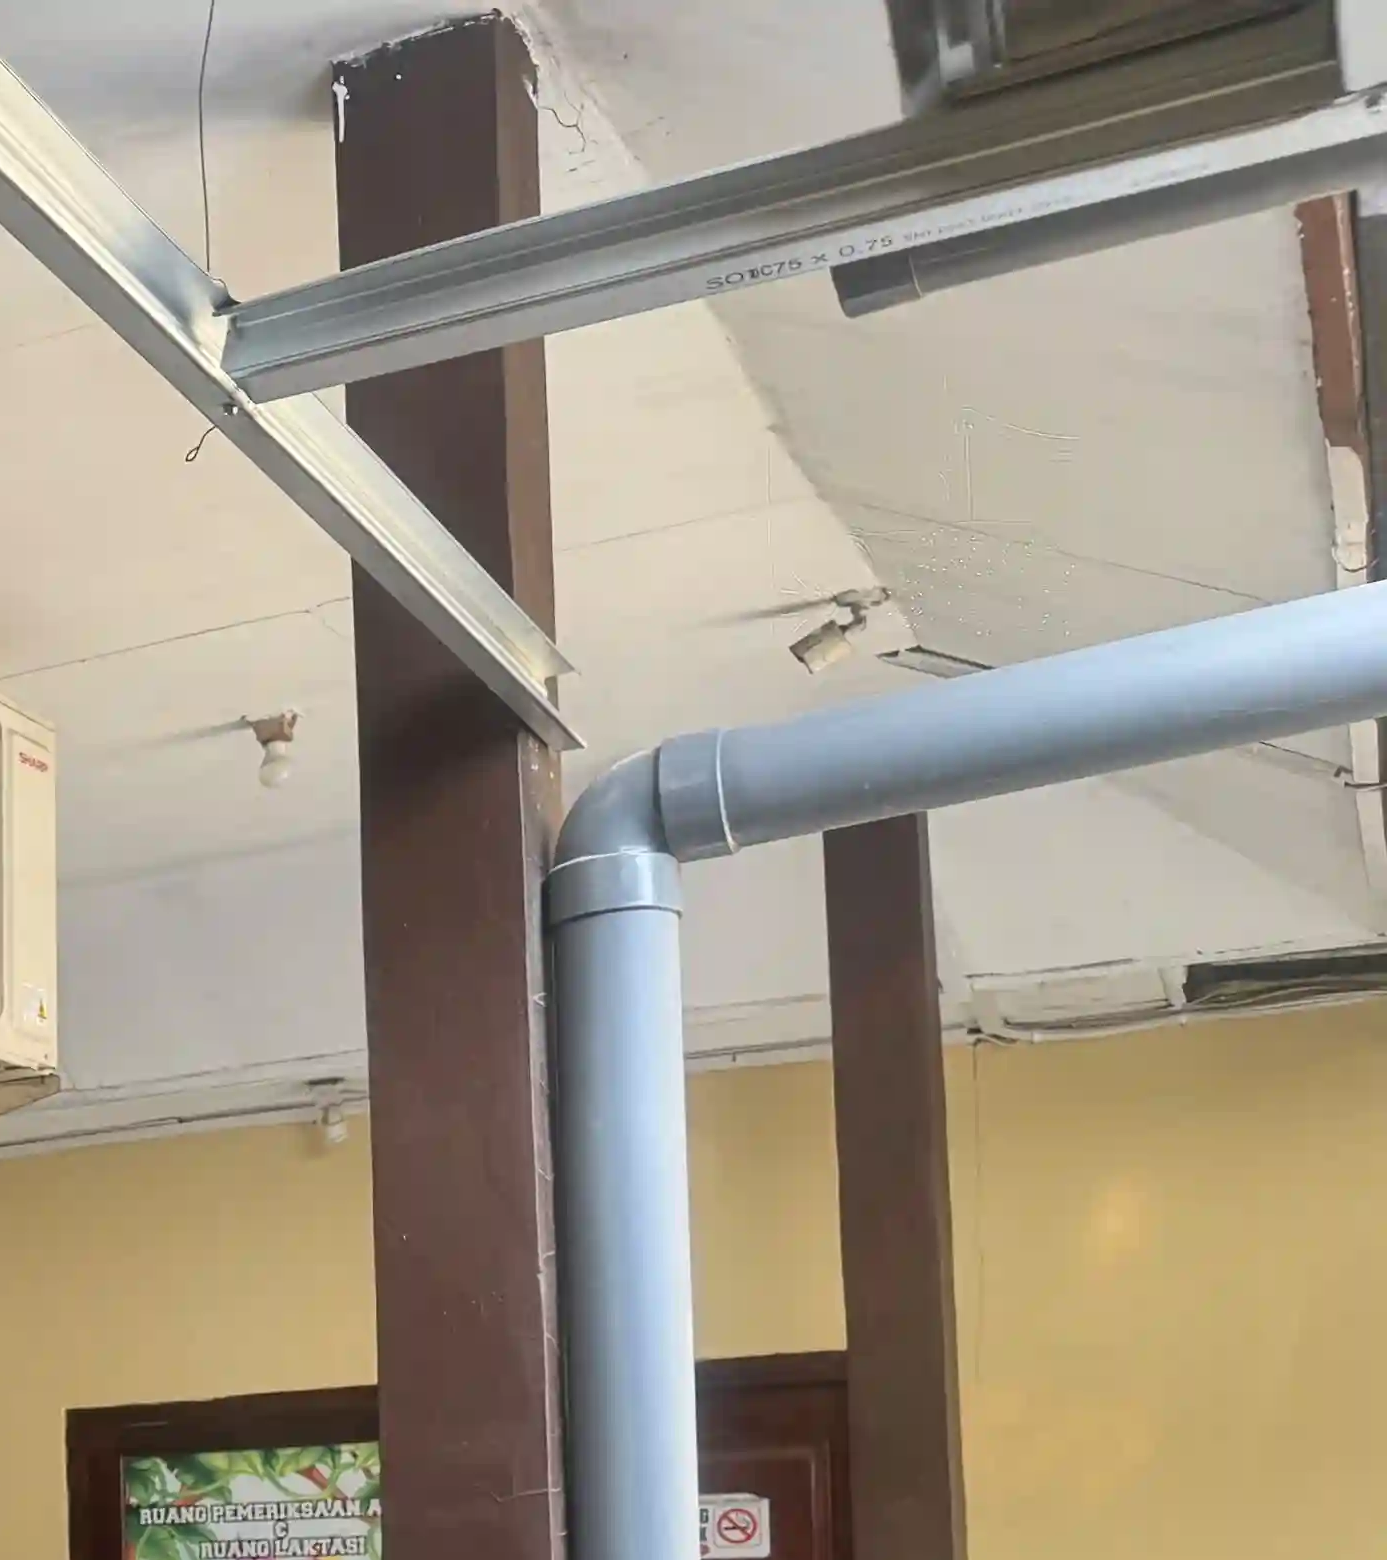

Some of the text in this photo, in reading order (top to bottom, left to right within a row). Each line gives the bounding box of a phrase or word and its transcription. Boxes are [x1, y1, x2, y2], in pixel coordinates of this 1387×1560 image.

[139, 1505, 207, 1525] RUANG
[212, 1500, 361, 1523] PEMERIKSAAN
[200, 1539, 269, 1560] RUANG
